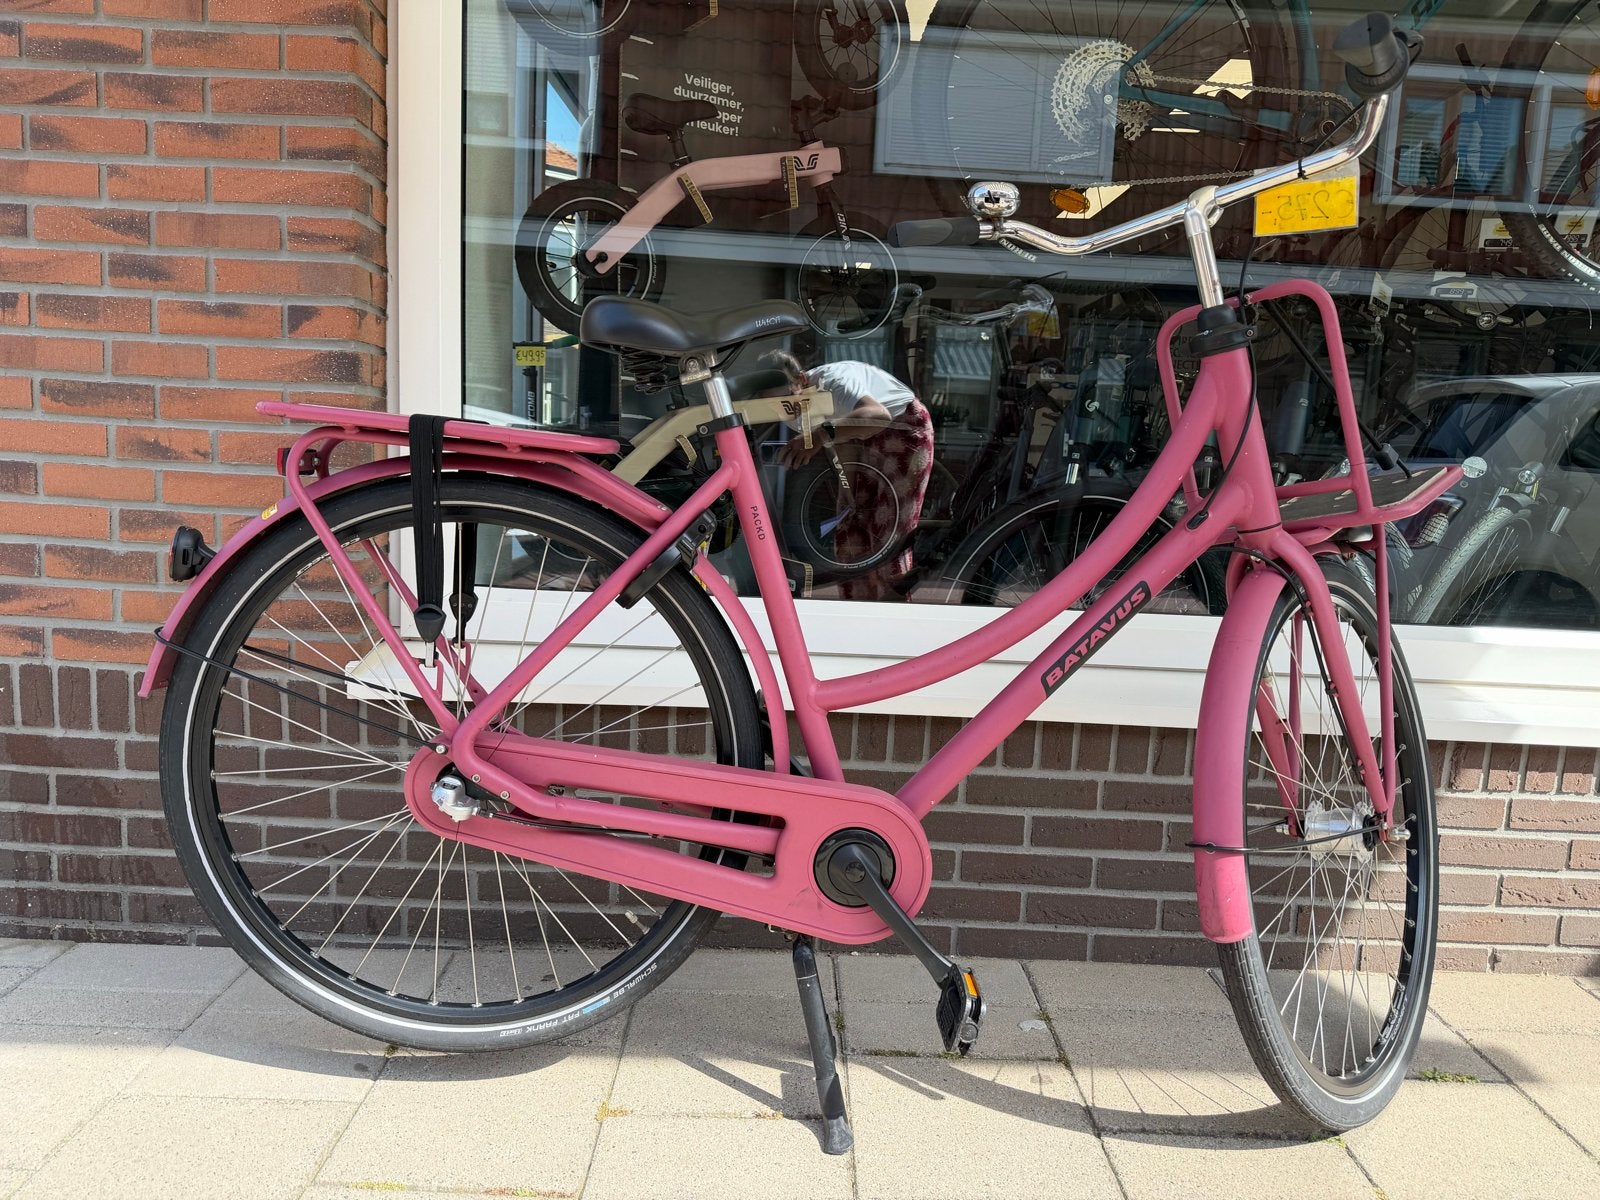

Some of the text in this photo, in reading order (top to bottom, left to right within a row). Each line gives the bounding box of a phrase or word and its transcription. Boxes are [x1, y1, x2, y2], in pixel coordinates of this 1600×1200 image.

[673, 85, 745, 112] duurzamer,
[684, 73, 735, 97] Veiliger,
[527, 391, 536, 423] YCOMB
[750, 505, 766, 541] PACKD
[1045, 587, 1146, 688] BATAVUS
[612, 962, 658, 1000] SCHWALBE
